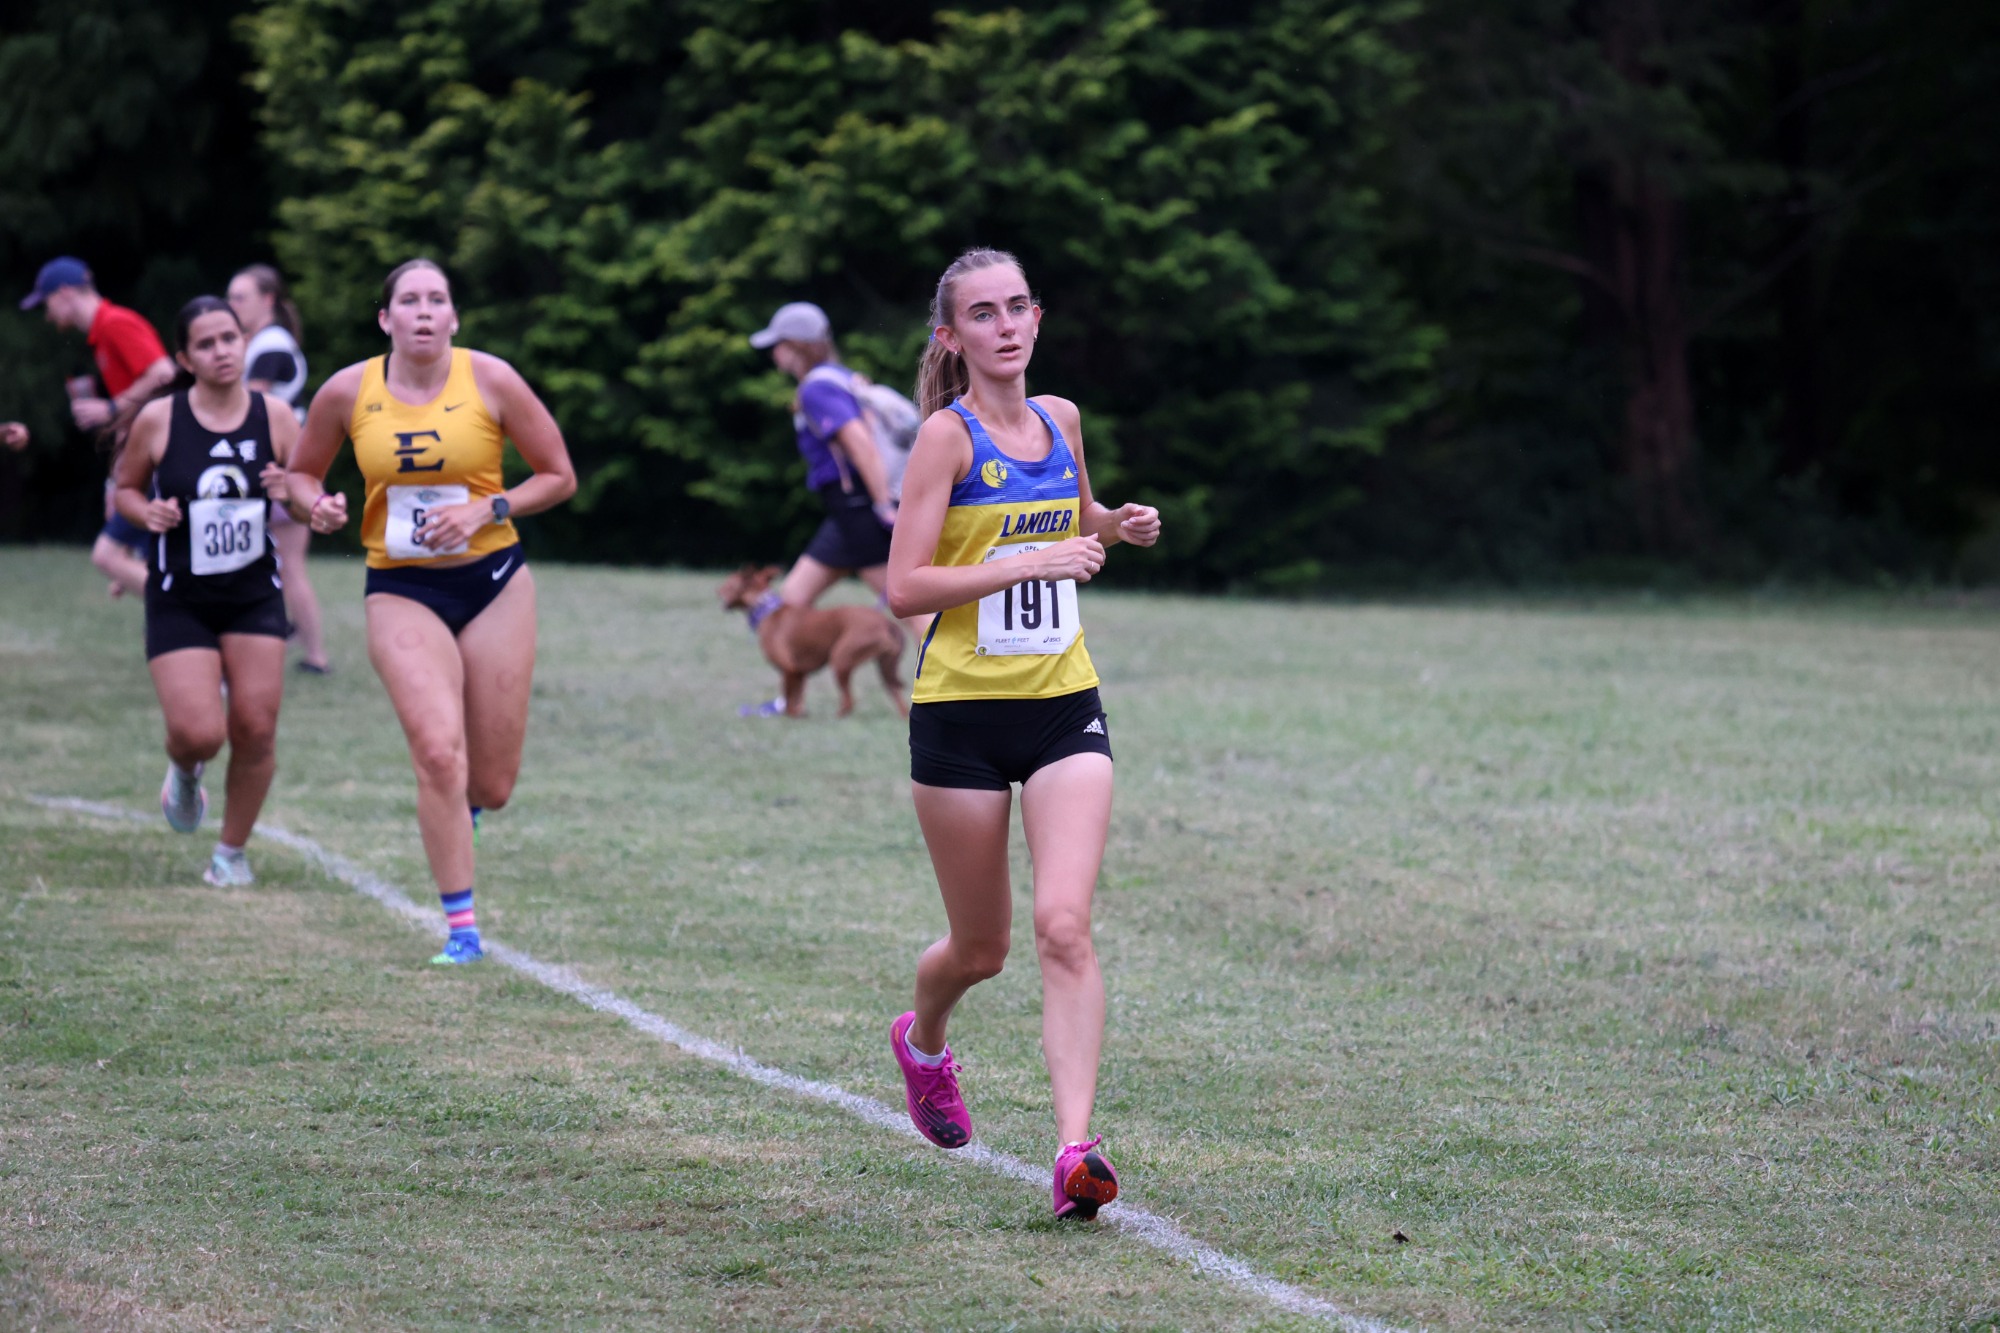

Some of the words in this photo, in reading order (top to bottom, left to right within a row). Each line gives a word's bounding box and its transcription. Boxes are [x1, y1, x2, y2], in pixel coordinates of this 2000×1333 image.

[394, 430, 444, 473] E
[206, 521, 250, 556] 303
[1000, 509, 1072, 537] LANDER
[1004, 579, 1059, 630] 191
